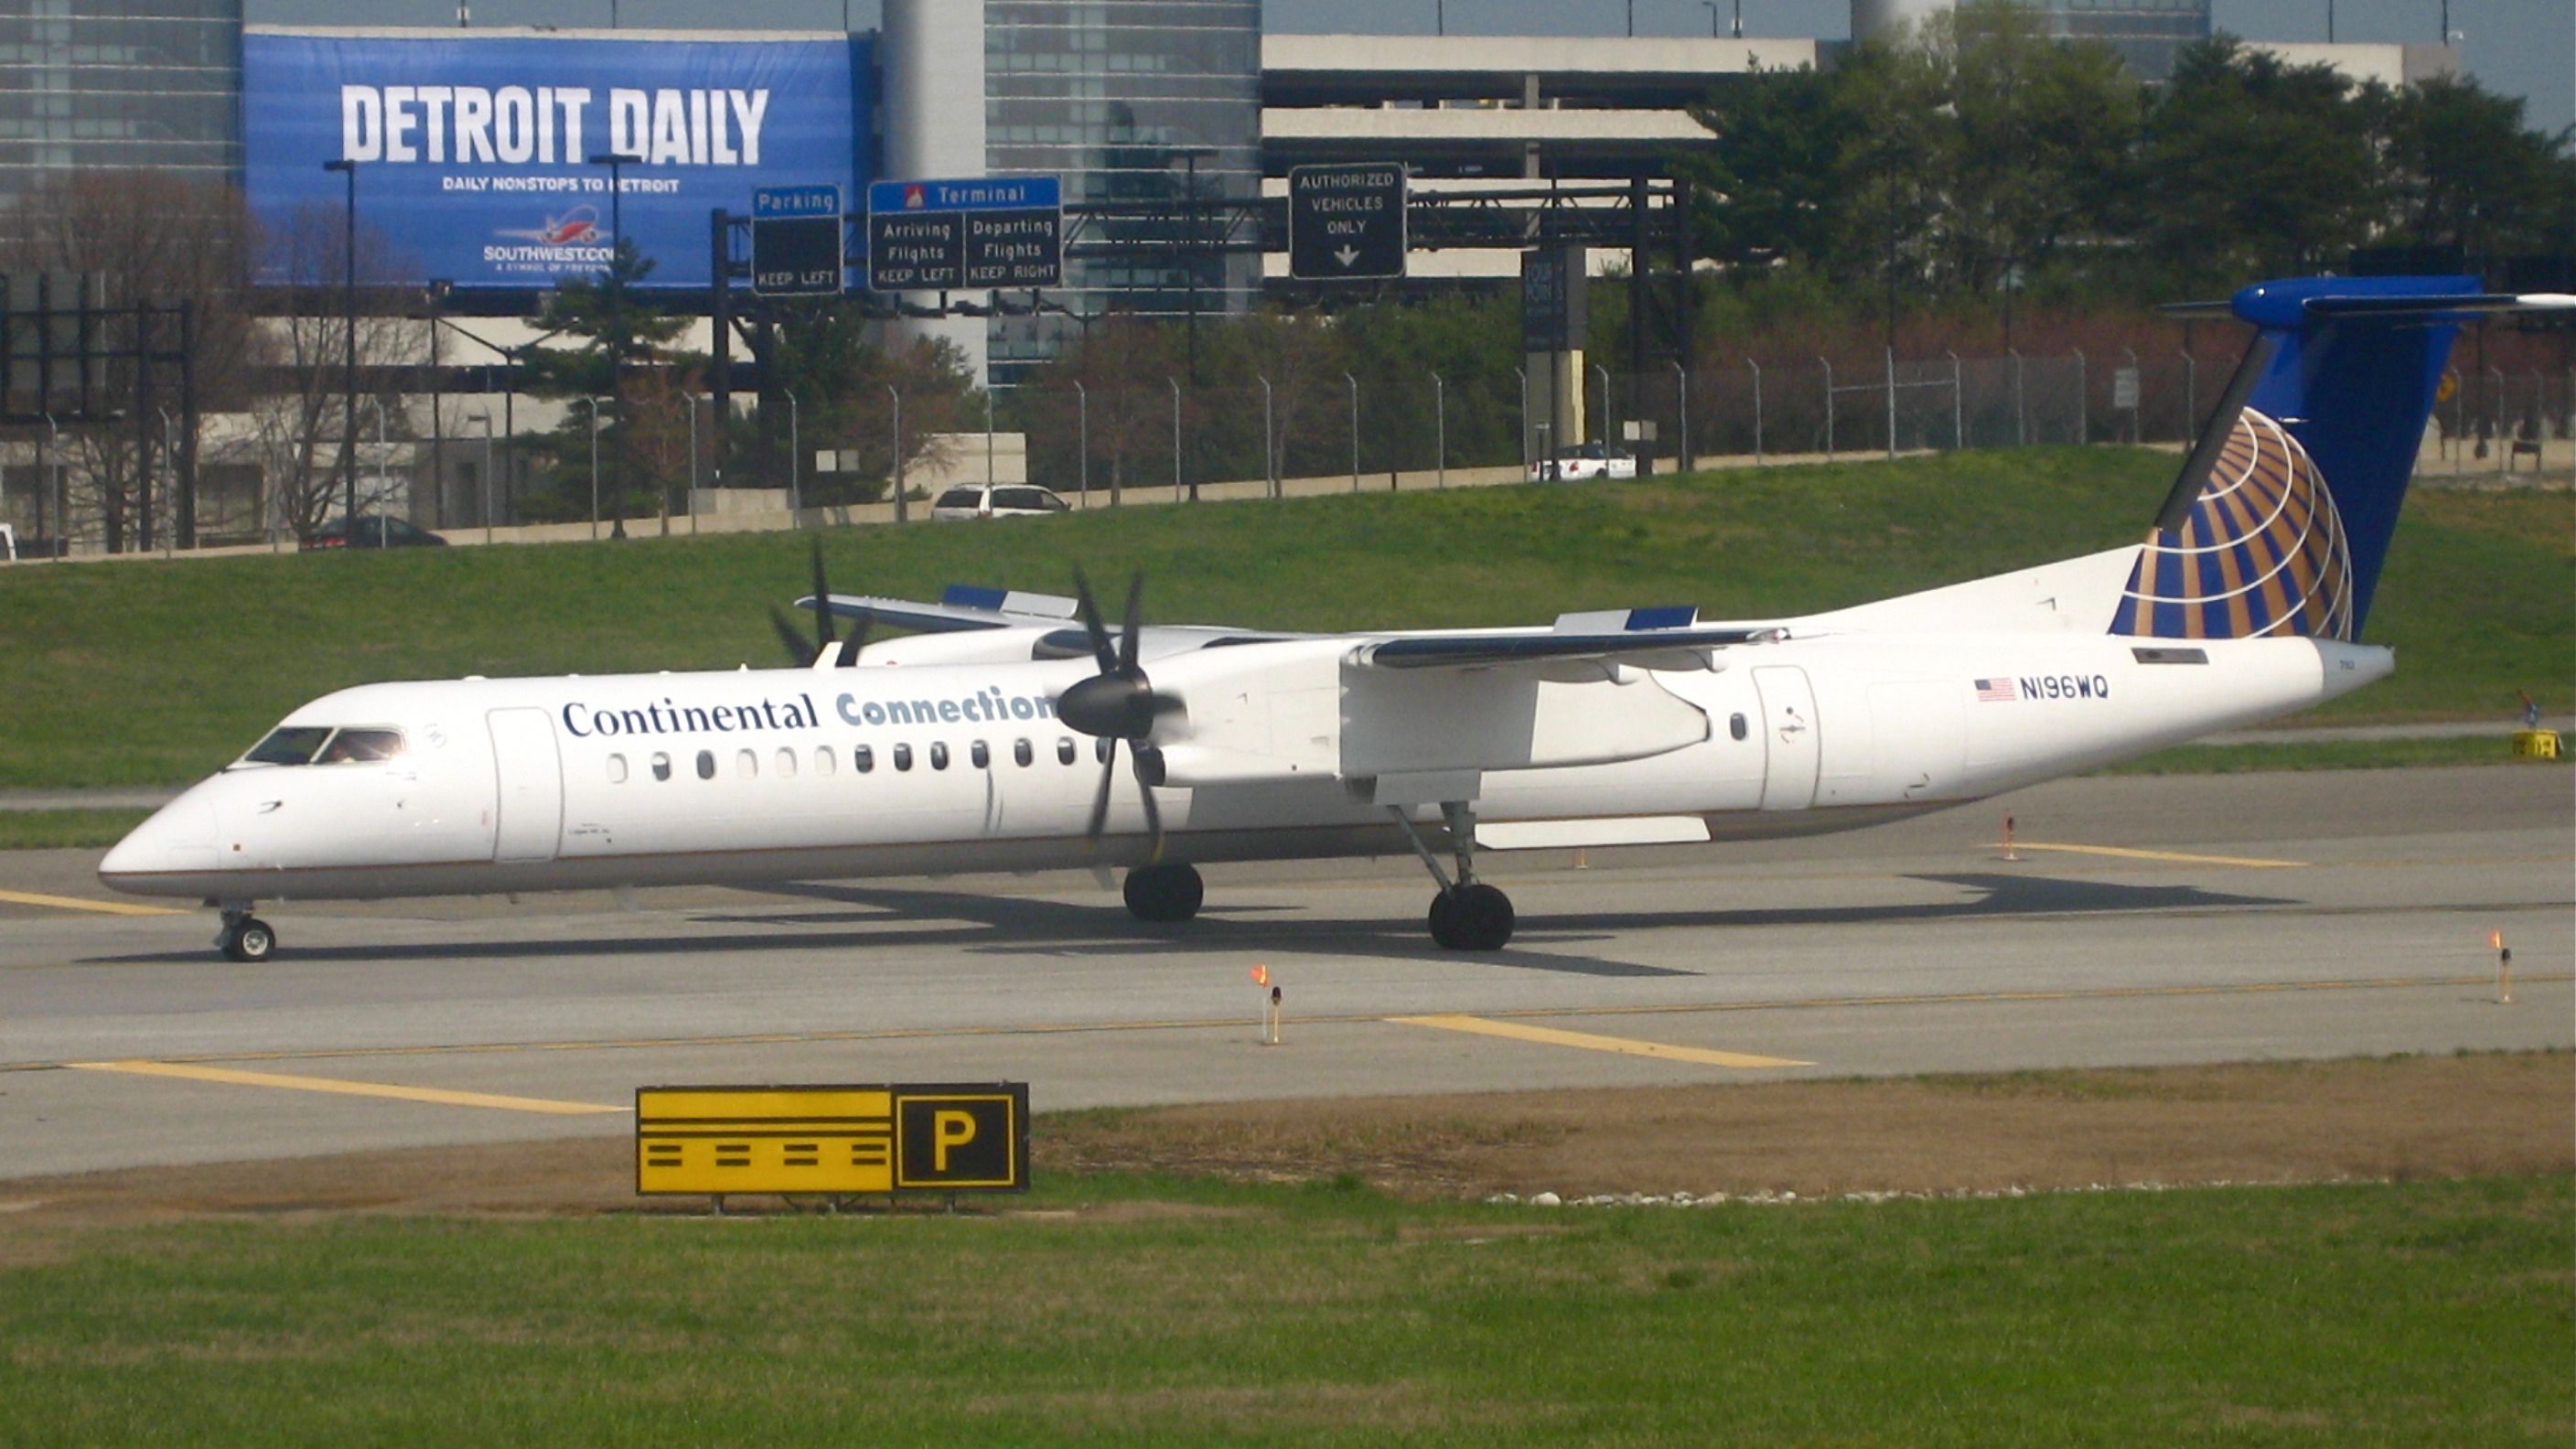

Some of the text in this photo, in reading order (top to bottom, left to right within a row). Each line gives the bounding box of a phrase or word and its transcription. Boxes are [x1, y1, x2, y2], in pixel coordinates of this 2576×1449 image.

[341, 84, 769, 165] DETROIT DAILY
[443, 177, 489, 190] DAILY
[493, 177, 579, 191] NONSTOPS
[583, 178, 604, 191] TO
[1300, 173, 1394, 189] AUTHORIZED
[758, 193, 834, 210] Parking
[938, 185, 1025, 203] Terminal
[1312, 197, 1383, 210] VEHICLES
[884, 223, 951, 241] Arriving
[972, 220, 1053, 236] Departing
[1327, 220, 1367, 234] ONLY
[888, 245, 945, 264] Flights
[984, 242, 1042, 262] Flights
[758, 270, 834, 286] KEEP LEFT
[877, 266, 955, 284] KEEP LEFT
[970, 264, 1055, 279] KEEP RIGHT
[2020, 674, 2109, 700] N196WQ
[562, 684, 1059, 738] Continental Connection
[934, 1109, 976, 1172] P
